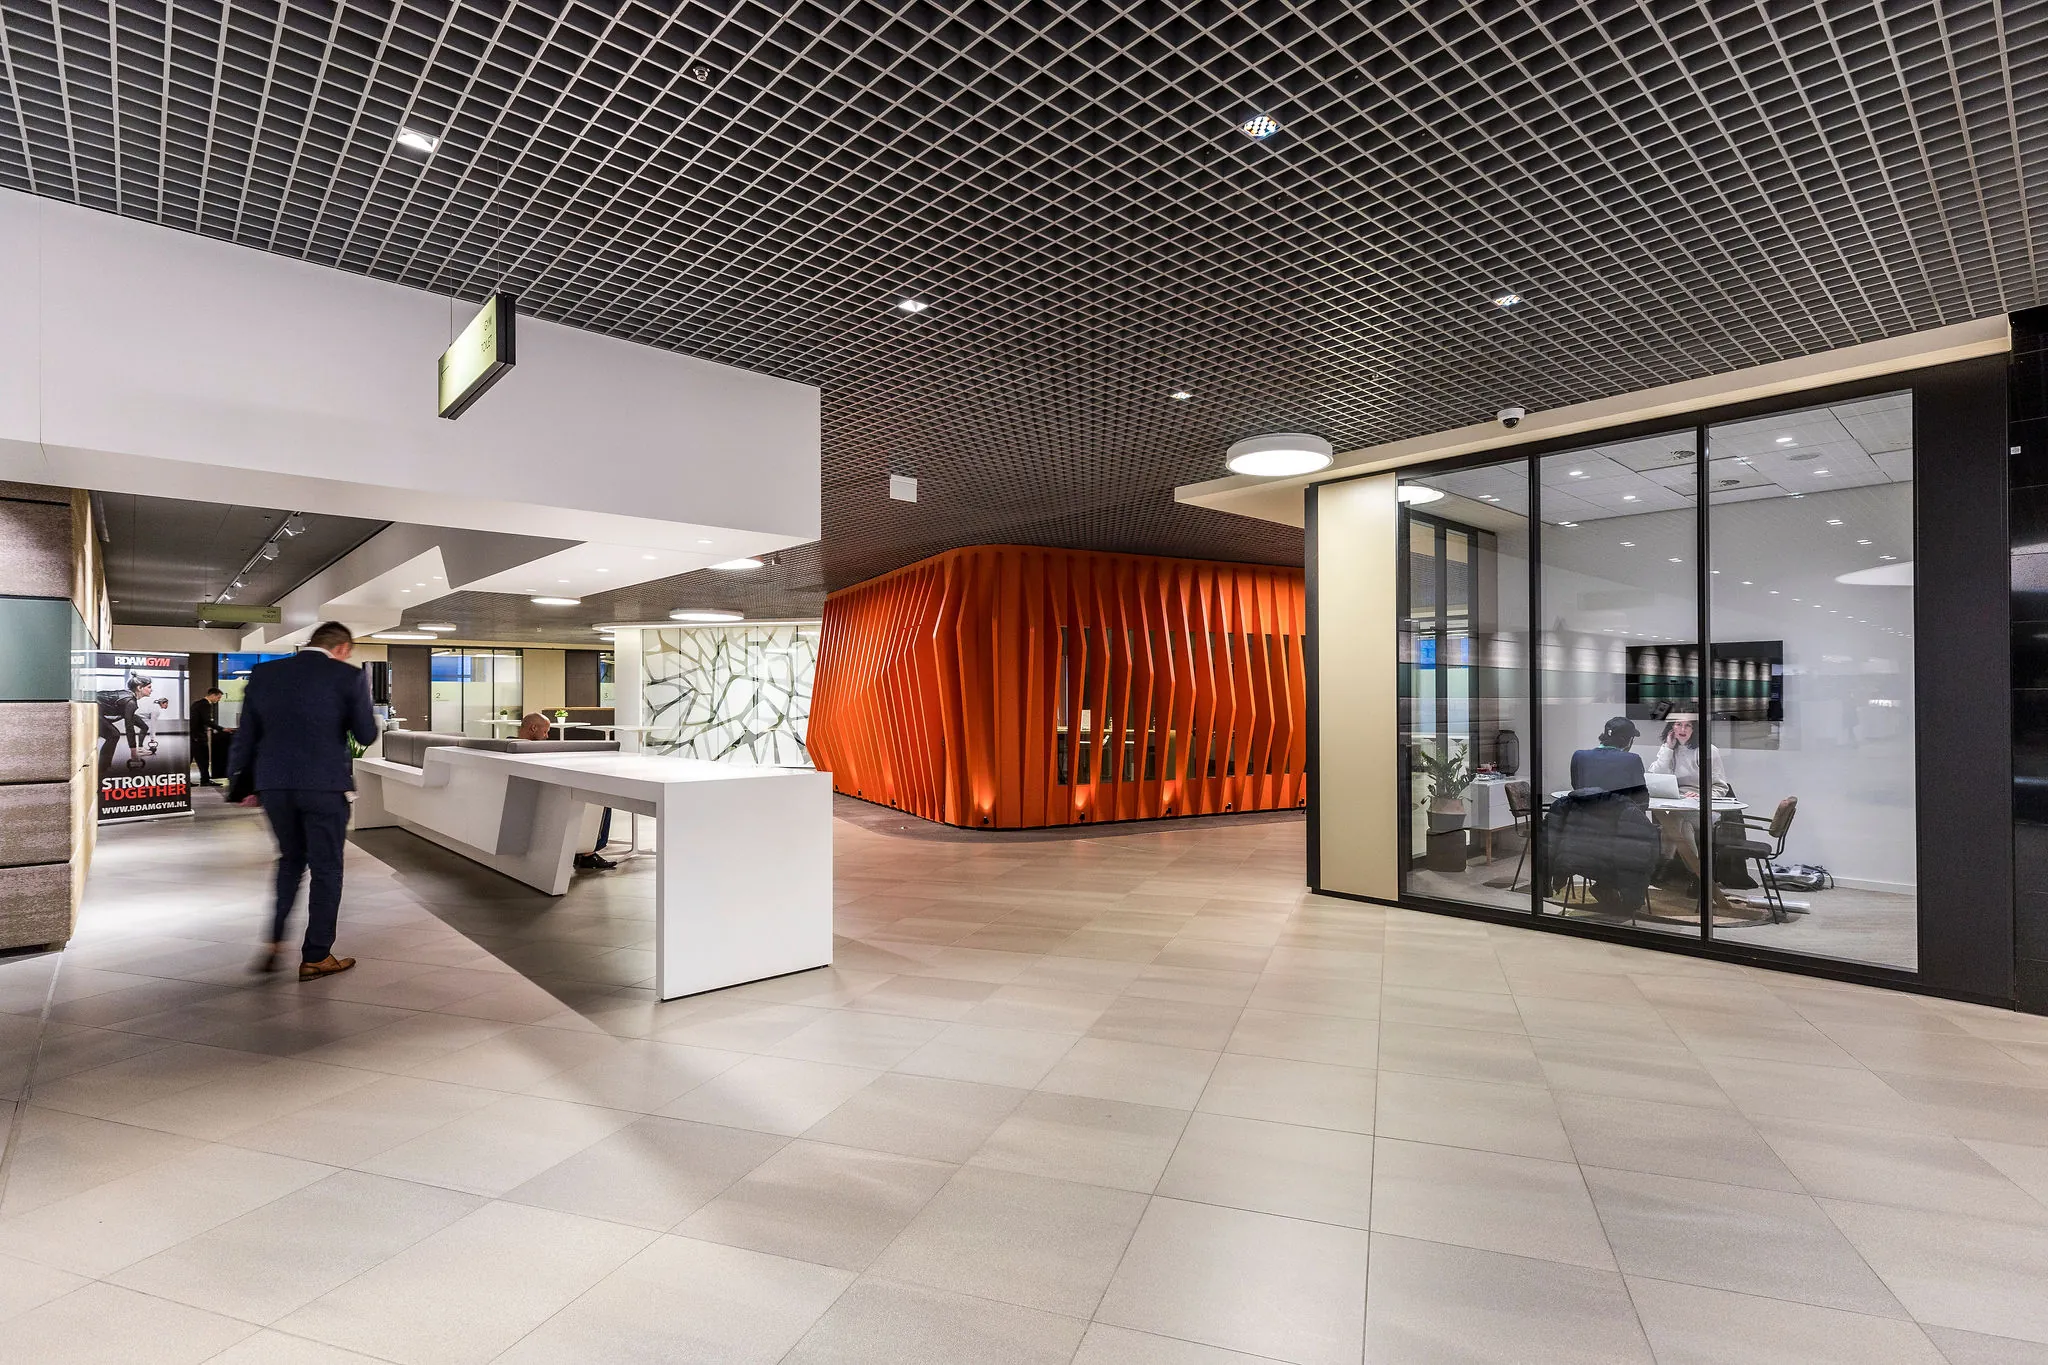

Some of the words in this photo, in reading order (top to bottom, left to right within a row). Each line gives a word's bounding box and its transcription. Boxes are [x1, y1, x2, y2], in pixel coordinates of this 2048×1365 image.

[114, 655, 170, 667] RDAMGYM
[102, 773, 187, 790] STRONGER
[102, 784, 187, 801] TOGETHER
[102, 801, 188, 815] WWW.RDAMGYM.NL
